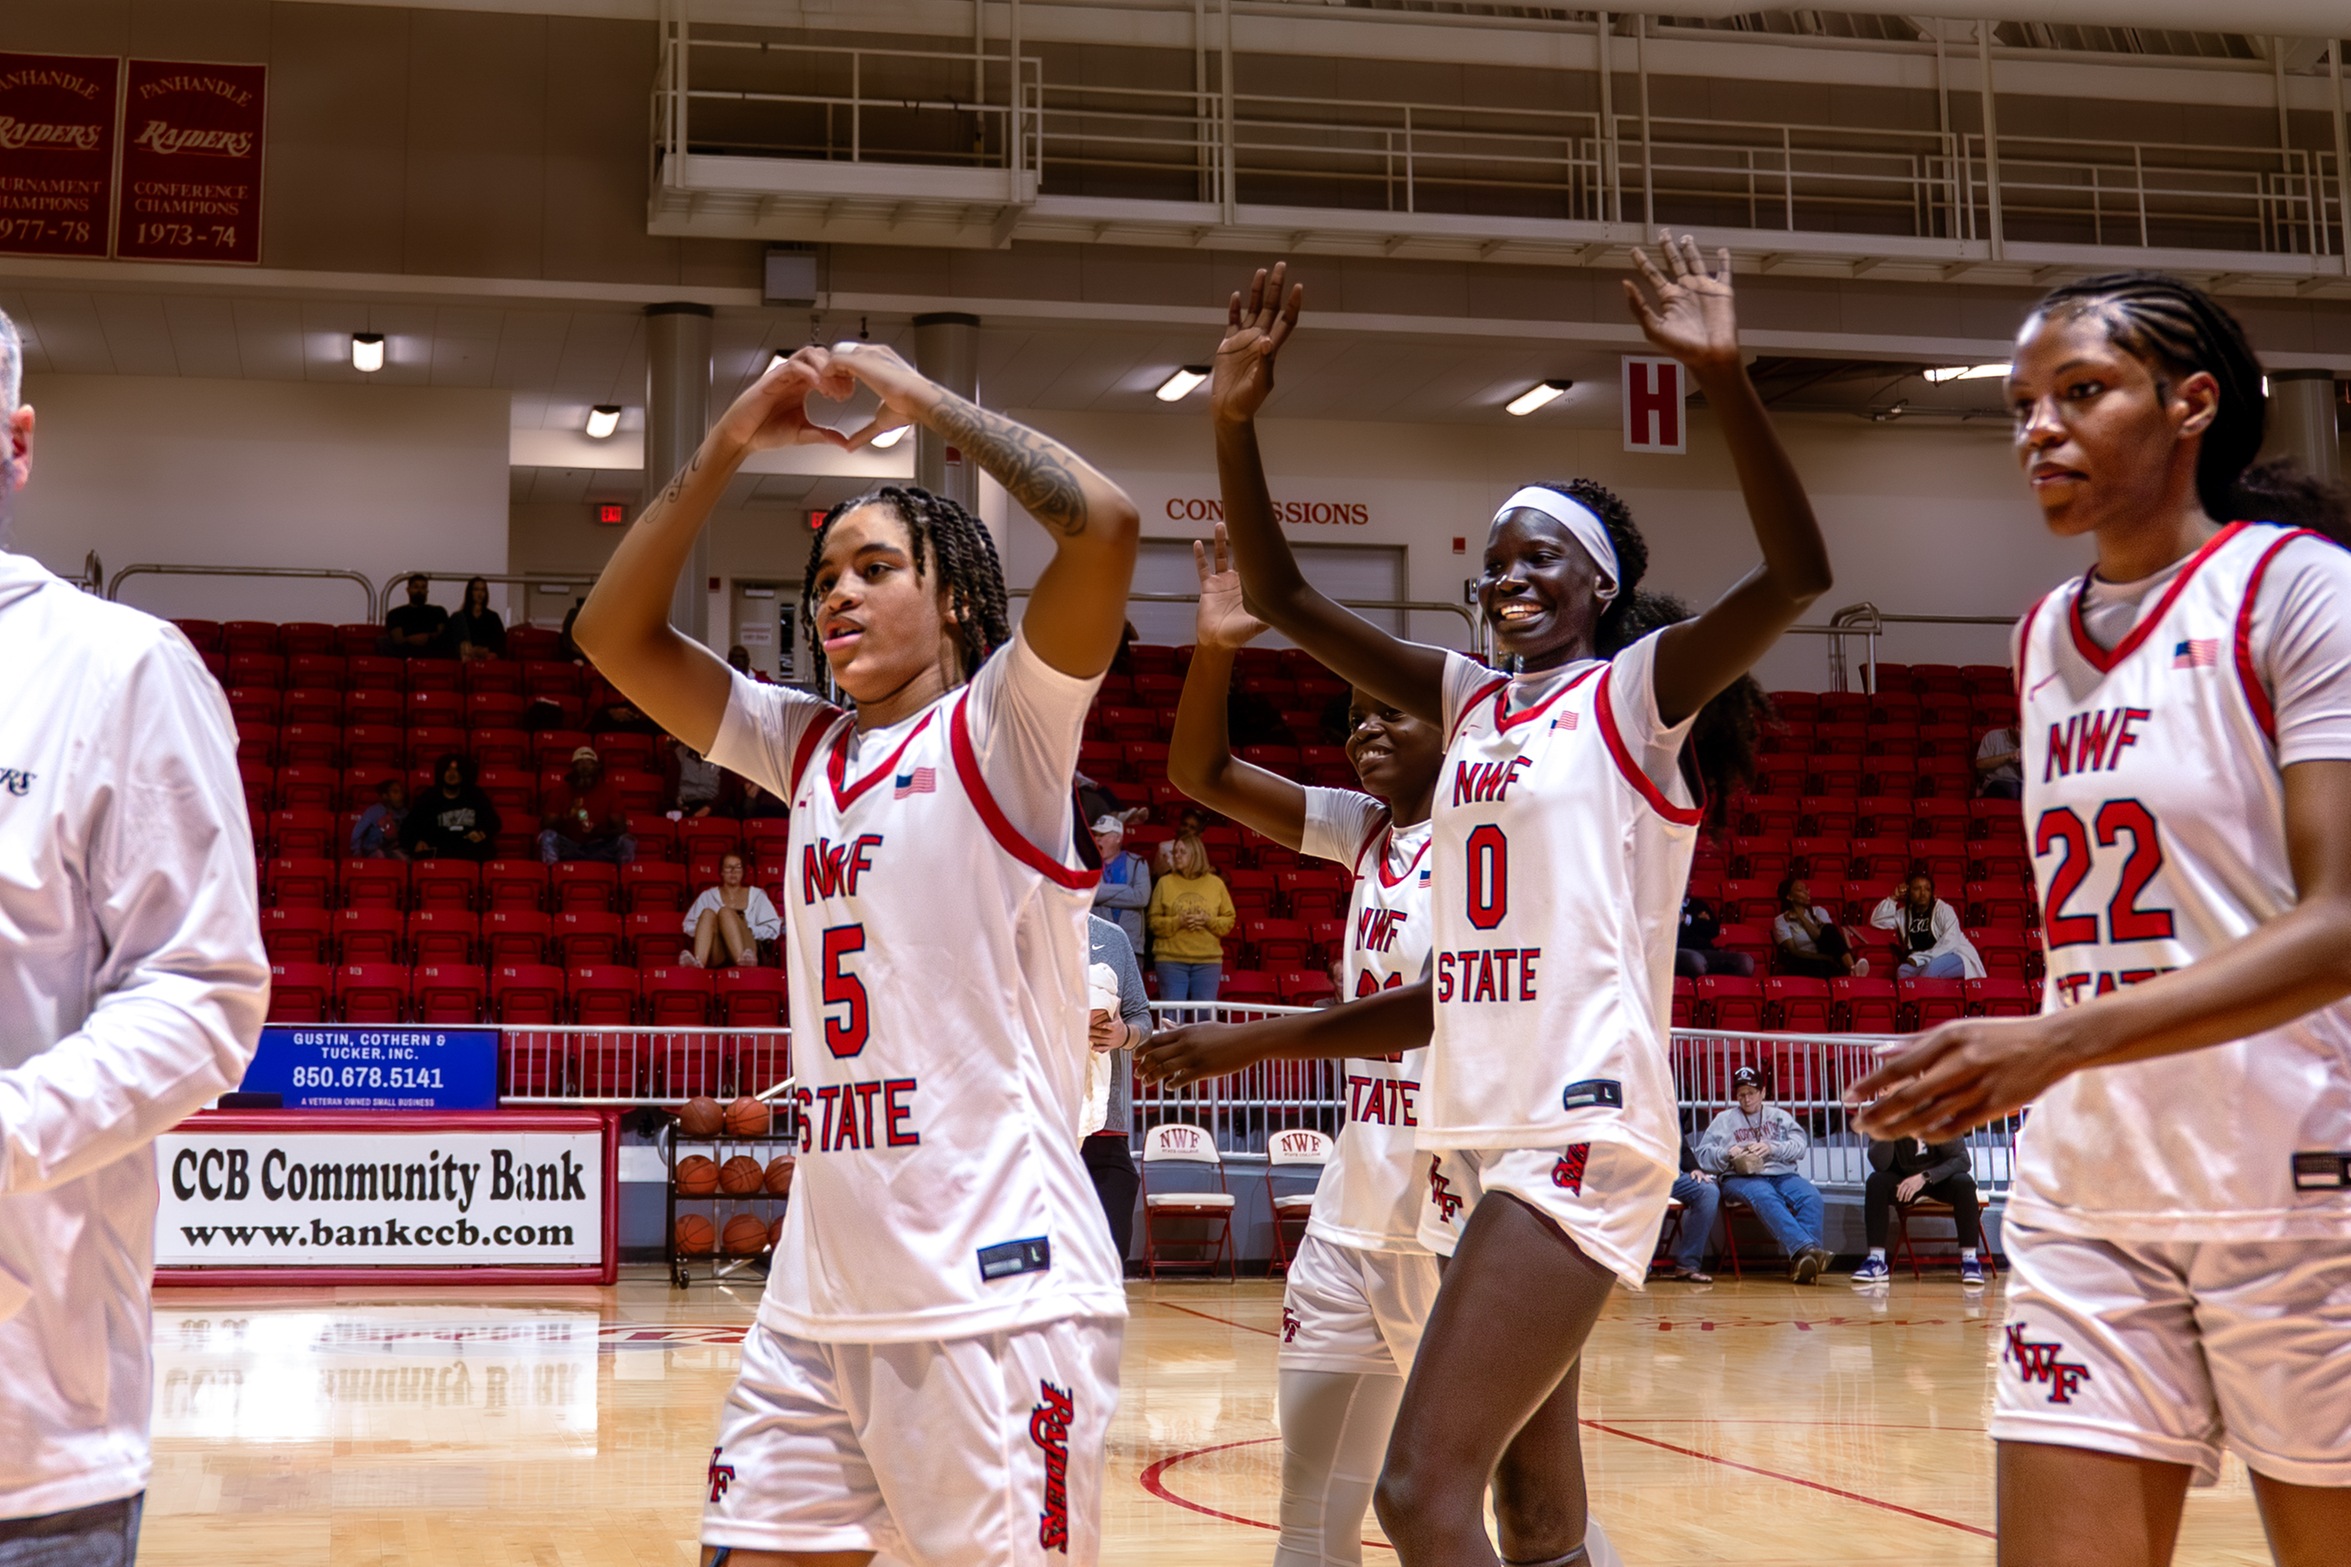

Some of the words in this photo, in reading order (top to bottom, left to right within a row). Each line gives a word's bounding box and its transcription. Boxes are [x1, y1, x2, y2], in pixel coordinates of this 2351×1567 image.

[139, 76, 252, 107] PANHANDLE
[134, 120, 253, 157] RAIDERS
[134, 182, 248, 199] CONFERENCE
[135, 199, 239, 215] CHAMPIONS
[137, 223, 236, 248] 1973-74
[1629, 362, 1678, 447] H
[1166, 498, 1369, 525] CONSSIONS
[2043, 707, 2152, 783] NWF
[1453, 756, 1533, 807] NWF
[803, 834, 883, 905] NWF
[1466, 823, 1507, 930] 0
[2036, 799, 2175, 951] 22
[1356, 906, 1408, 953] NWF
[822, 922, 869, 1059] 5
[1438, 947, 1541, 1003] STATE
[293, 1033, 355, 1047] GUSTIN,
[360, 1034, 430, 1046] COTHERN
[436, 1034, 446, 1046] &
[321, 1047, 385, 1061] TUCKER,
[388, 1048, 419, 1060] INC.
[292, 1066, 444, 1088] 850.678.5141
[301, 1097, 307, 1106] A
[308, 1097, 342, 1106] VETERAN
[344, 1097, 371, 1107] OWNED
[373, 1098, 396, 1107] SMALL
[398, 1098, 434, 1107] BUSINESS
[796, 1078, 920, 1153] STATE
[1160, 1128, 1201, 1149] NWF
[1281, 1133, 1322, 1153] NWF
[172, 1148, 249, 1201] CCB
[261, 1148, 481, 1213] Community
[491, 1149, 586, 1201] Bank
[180, 1218, 574, 1247] www.bankccb.com
[2004, 1323, 2091, 1404] NWF
